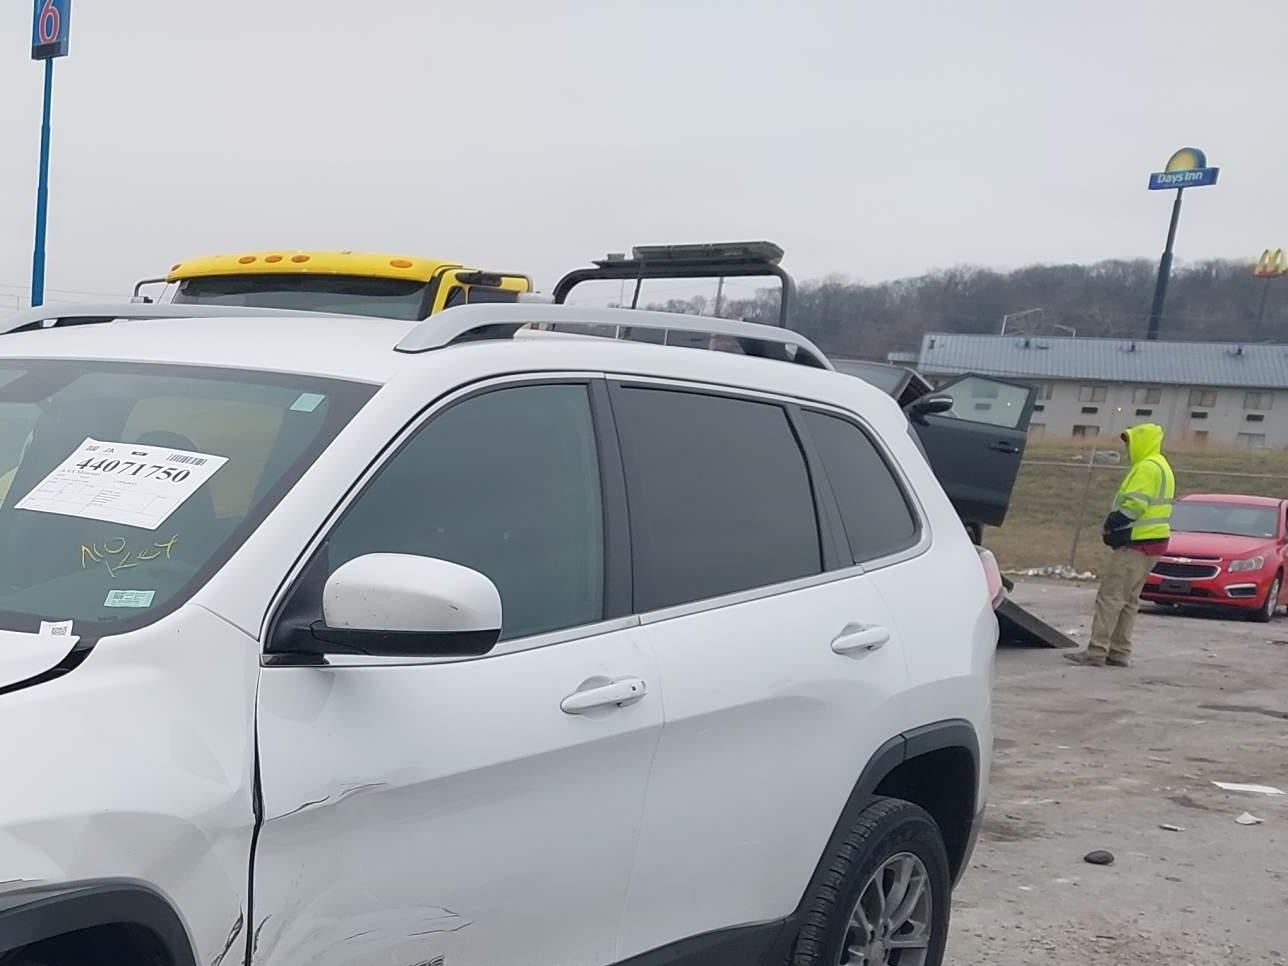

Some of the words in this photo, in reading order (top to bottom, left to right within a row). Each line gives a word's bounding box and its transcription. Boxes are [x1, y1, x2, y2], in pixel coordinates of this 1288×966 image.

[39, 0, 60, 44] 6
[1157, 173, 1183, 183] Days
[1185, 172, 1203, 181] Inn
[76, 457, 191, 483] 44071750
